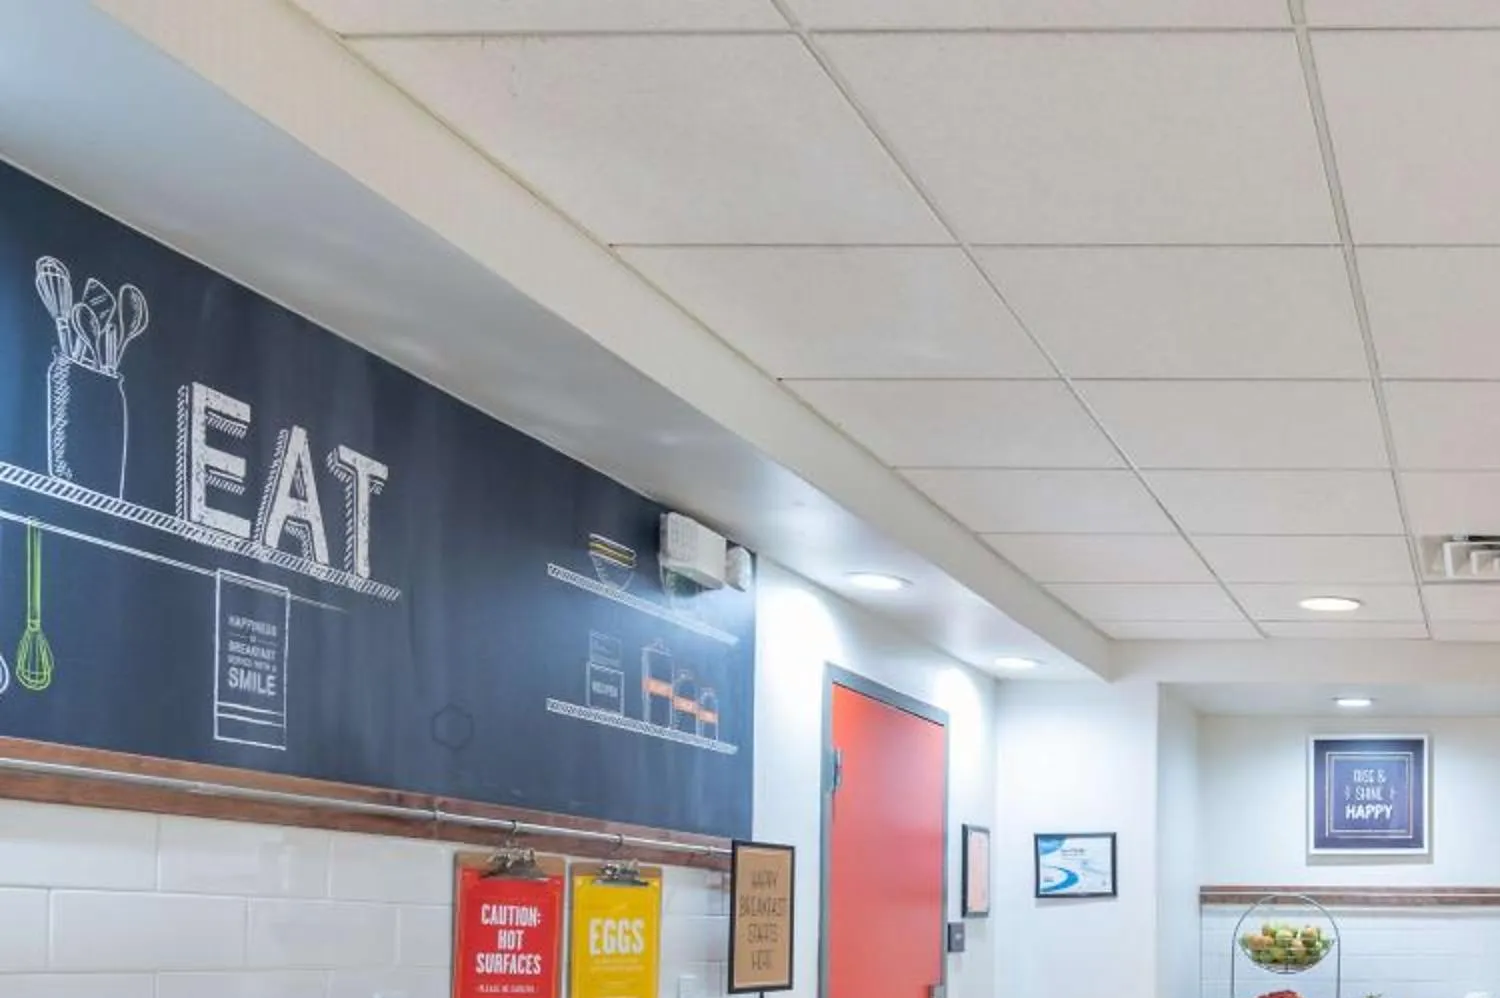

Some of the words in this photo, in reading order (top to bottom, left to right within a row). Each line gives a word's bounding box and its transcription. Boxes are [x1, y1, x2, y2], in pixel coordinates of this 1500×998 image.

[177, 381, 389, 579] EAT
[227, 666, 277, 697] SMILE
[1355, 785, 1384, 801] SHINE
[1344, 803, 1393, 820] HAPPY
[480, 903, 542, 928] CAUTION:
[497, 929, 525, 951] HOT
[588, 917, 645, 956] EGGS
[475, 952, 542, 976] SURFACES
